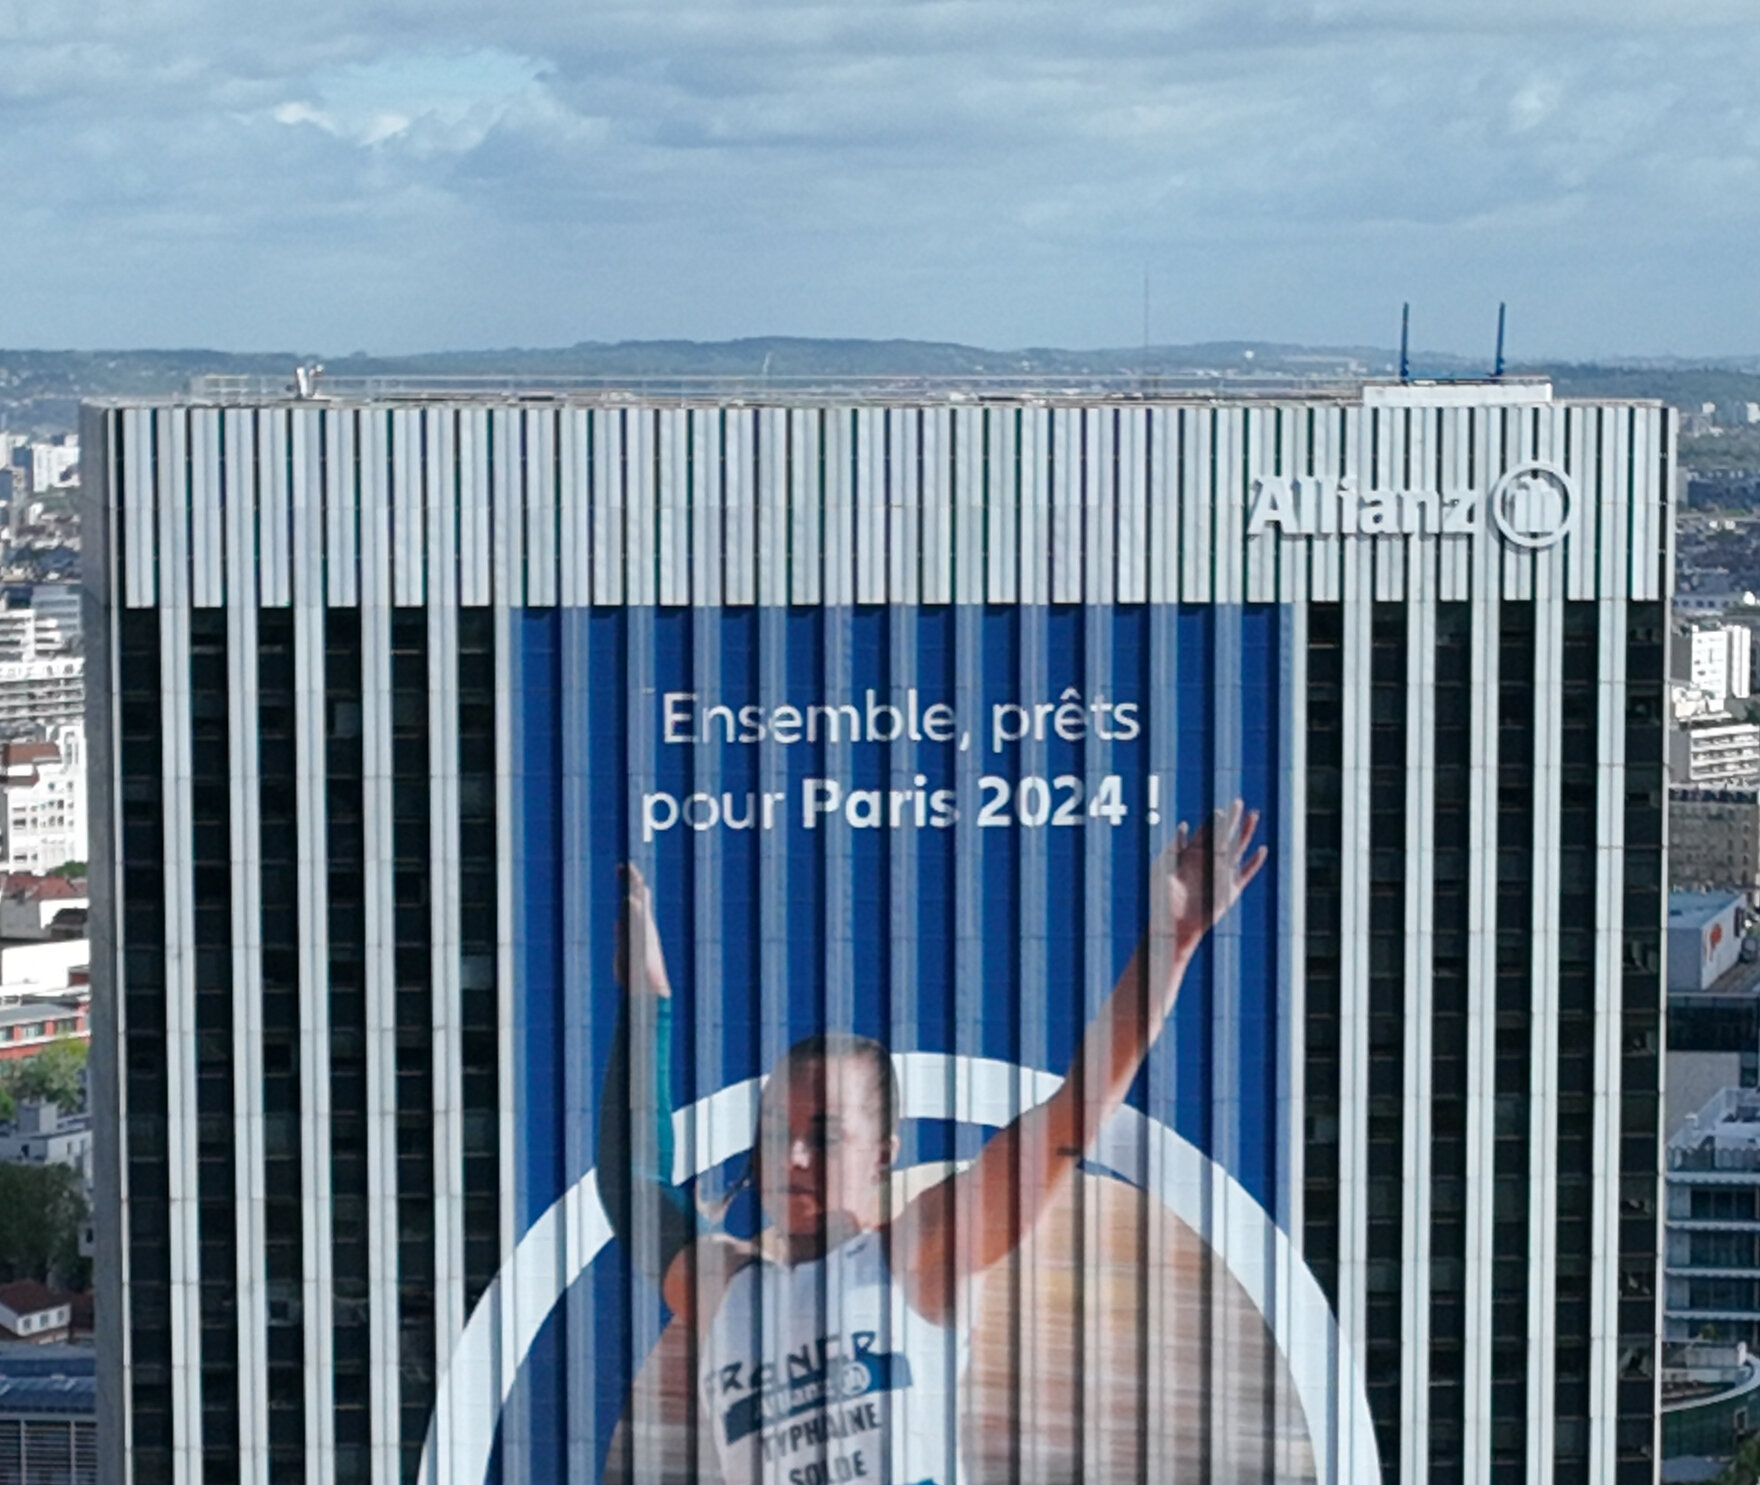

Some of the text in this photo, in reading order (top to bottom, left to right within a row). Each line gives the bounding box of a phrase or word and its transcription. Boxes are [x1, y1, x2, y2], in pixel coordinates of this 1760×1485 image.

[1247, 474, 1476, 535] Allianz
[663, 687, 1140, 752] Ensemble, prêts
[641, 789, 783, 842] pour
[801, 775, 958, 828] Paris
[977, 776, 1128, 827] 2024
